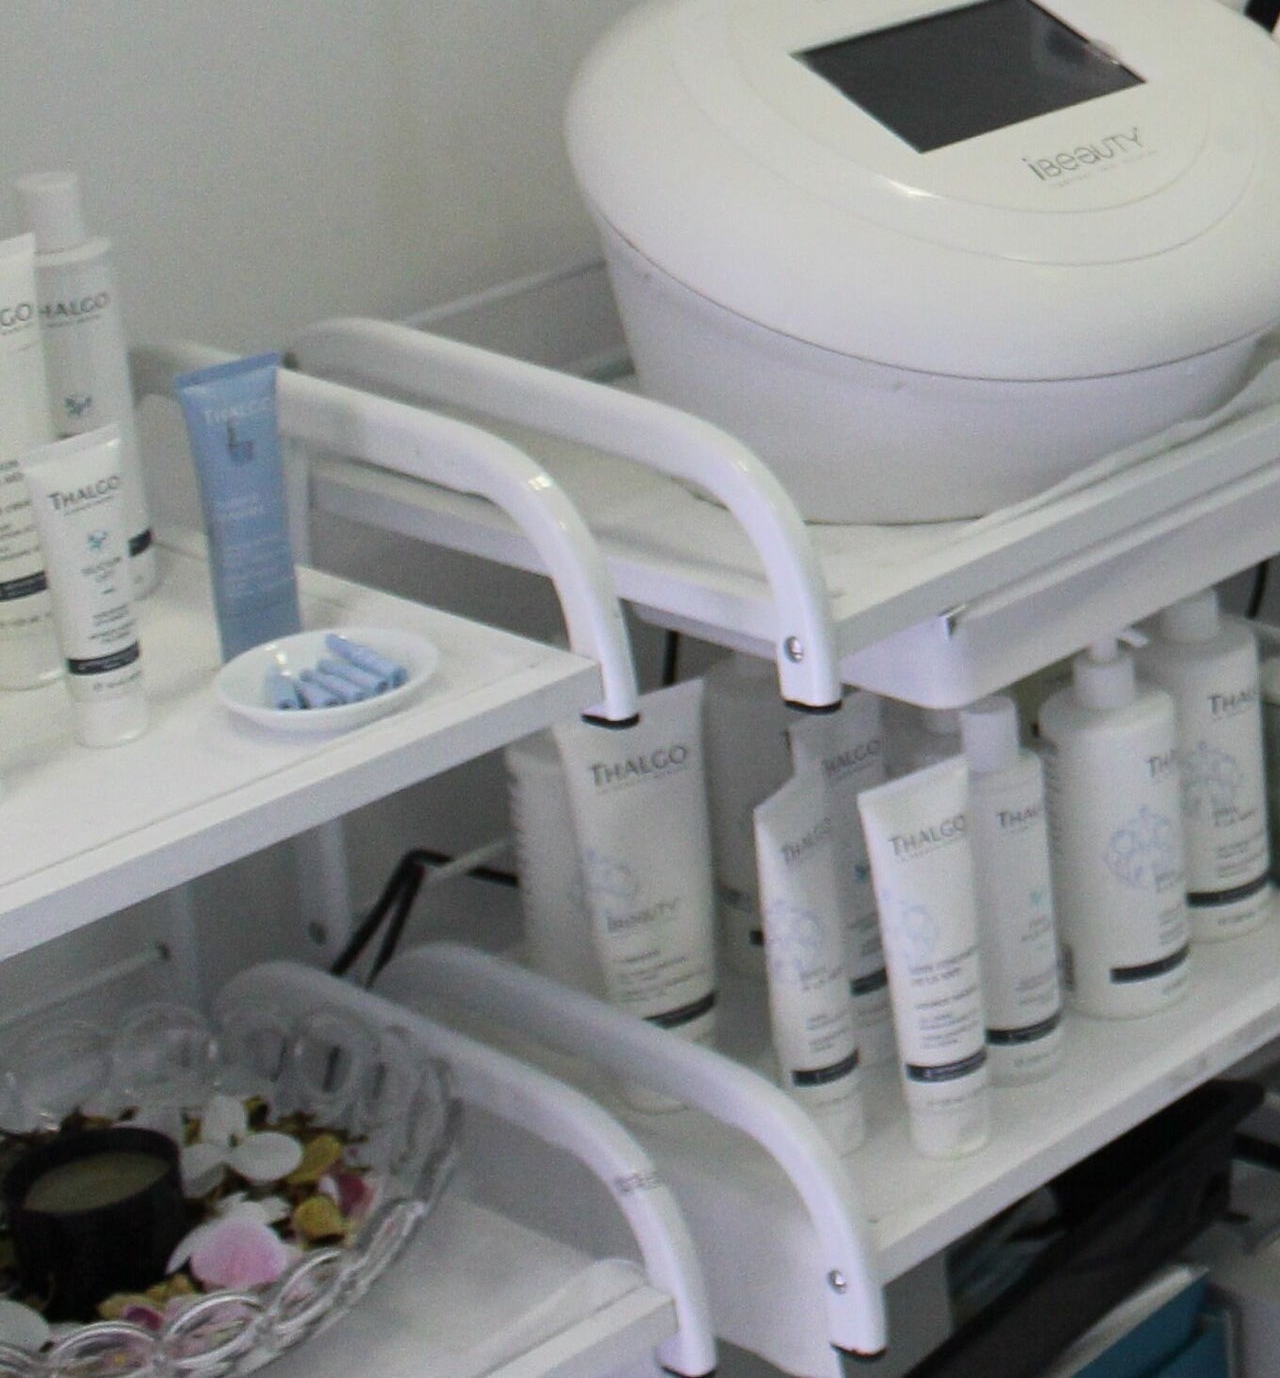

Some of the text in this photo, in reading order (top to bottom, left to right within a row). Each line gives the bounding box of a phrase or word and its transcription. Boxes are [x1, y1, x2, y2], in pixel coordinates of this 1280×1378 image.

[47, 475, 121, 511] THALGO
[589, 744, 687, 787] THALGO
[888, 814, 968, 857] THALGO
